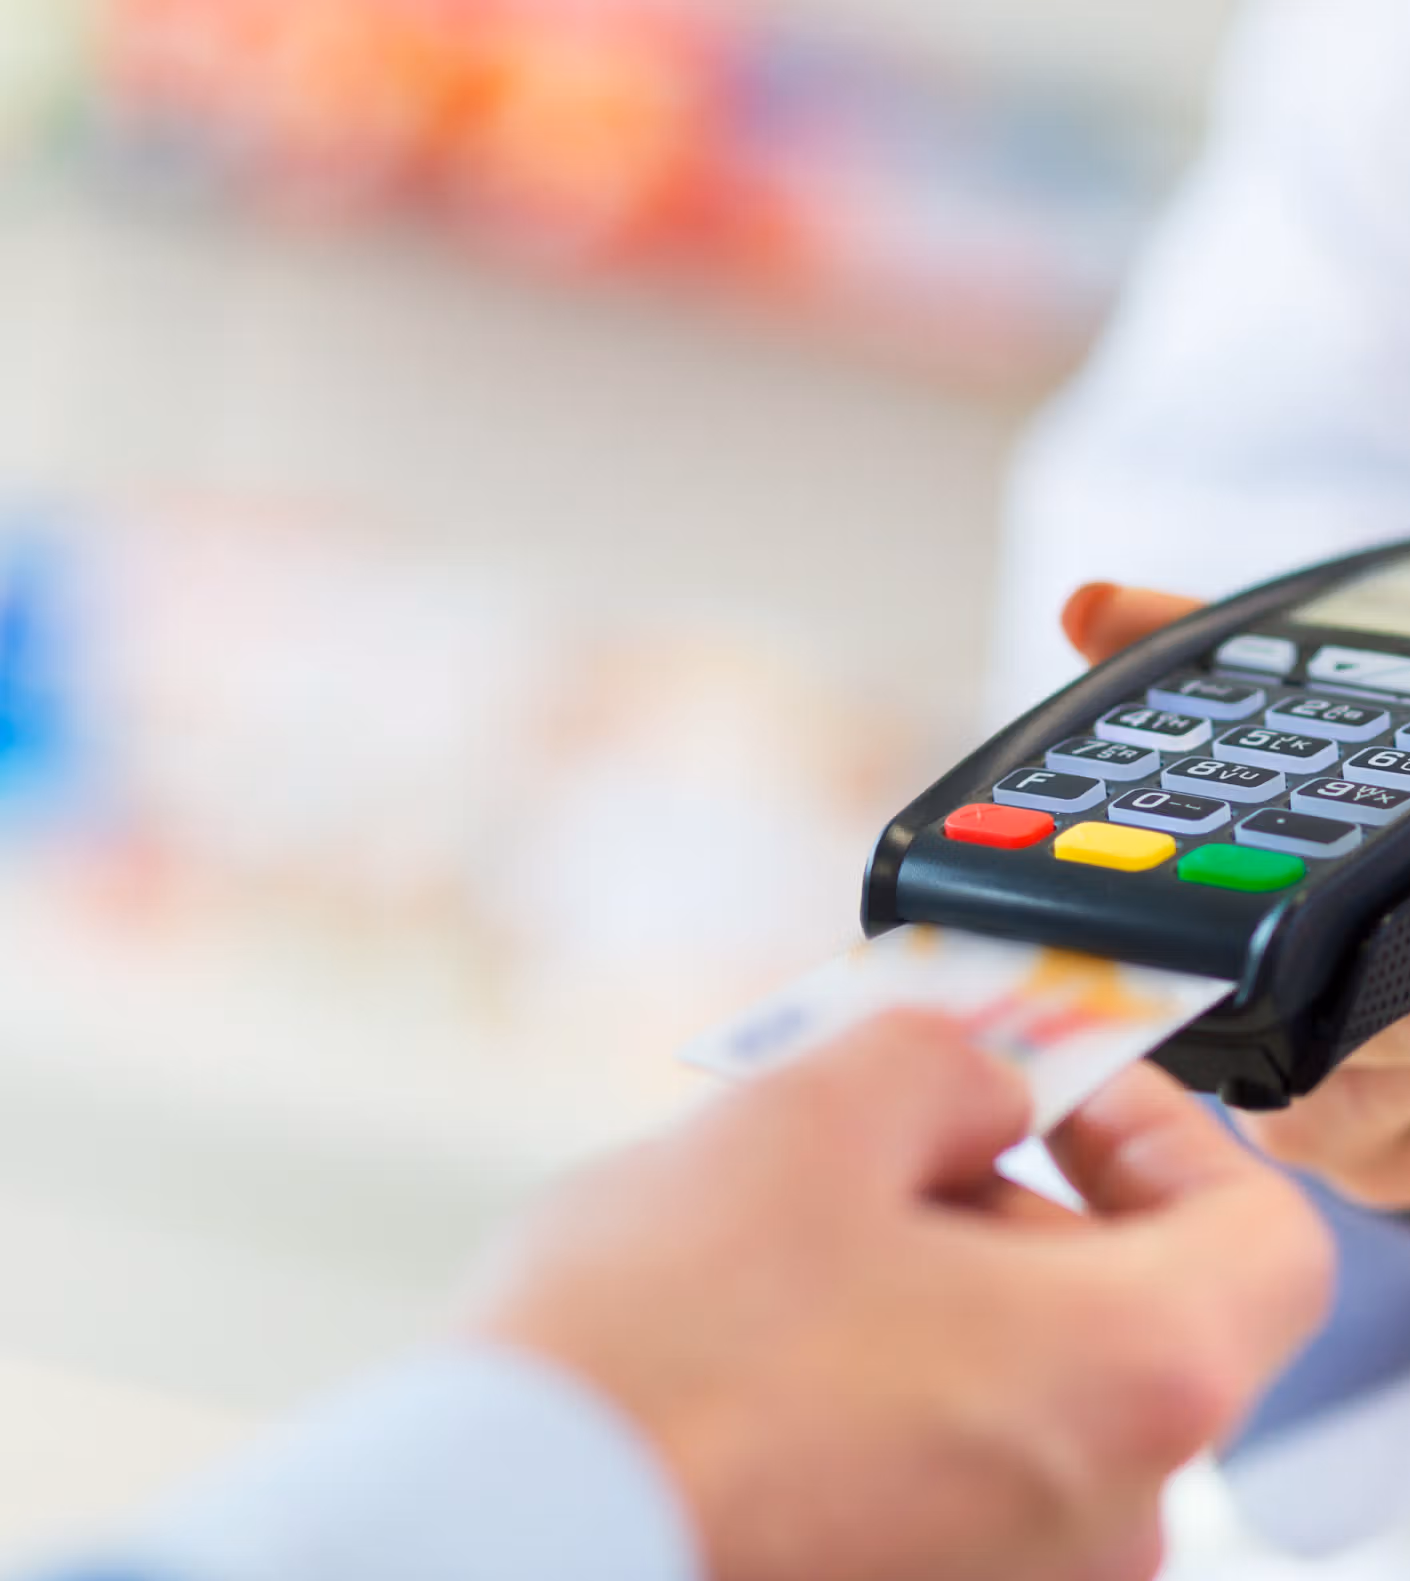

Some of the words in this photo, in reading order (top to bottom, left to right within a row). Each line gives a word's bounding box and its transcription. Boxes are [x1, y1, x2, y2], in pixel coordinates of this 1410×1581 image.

[1291, 700, 1330, 715] 2
[1120, 709, 1153, 726] 4
[1239, 730, 1280, 746] 5
[1072, 740, 1109, 754] 7
[1368, 751, 1405, 767] 6
[1187, 761, 1225, 775] 8
[1016, 772, 1056, 788] F
[1317, 782, 1355, 796] 9
[1132, 792, 1171, 808] 0
